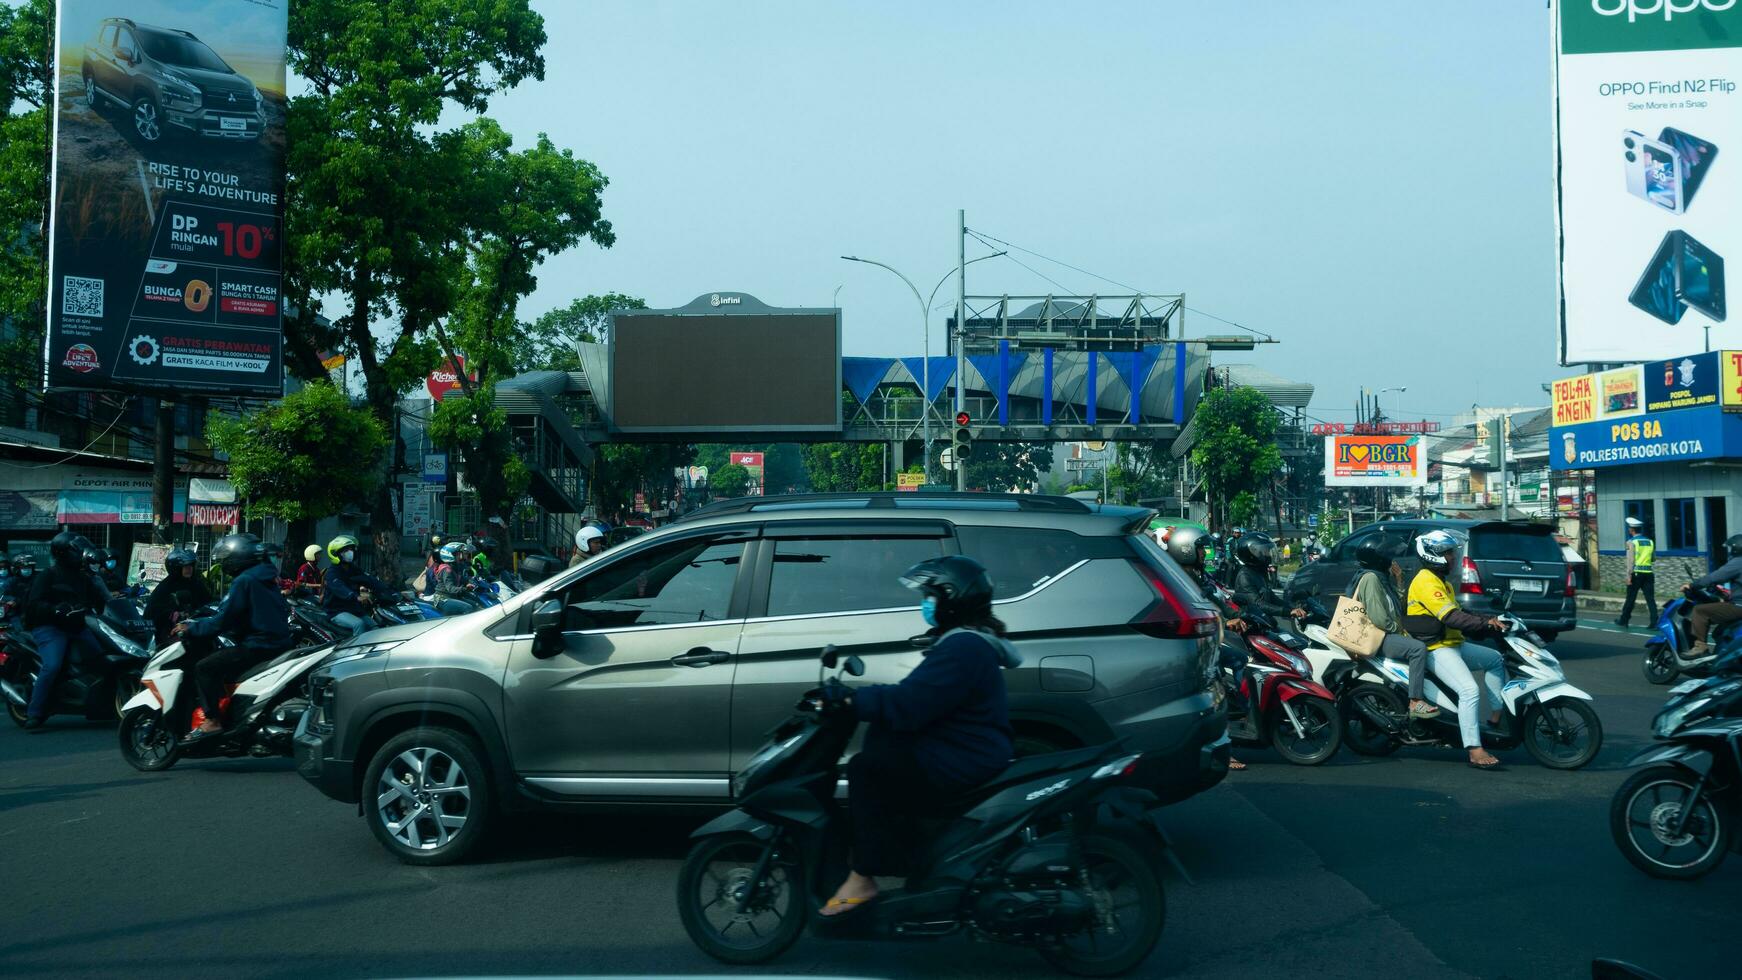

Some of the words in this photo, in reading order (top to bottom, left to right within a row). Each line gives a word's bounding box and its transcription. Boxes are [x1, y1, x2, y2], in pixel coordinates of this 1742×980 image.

[1599, 82, 1645, 96] OPPO
[1649, 81, 1681, 94] Find
[1684, 80, 1706, 93] N2
[1709, 79, 1736, 94] Flip
[1627, 102, 1644, 111] See
[1645, 101, 1668, 110] More
[1669, 100, 1678, 109] in
[1685, 99, 1707, 110] Snap
[149, 162, 179, 178] RISE
[183, 167, 200, 180] TO
[203, 171, 239, 186] YOUR
[155, 178, 195, 193] LIFE'S
[199, 184, 278, 205] ADVENTURE
[172, 214, 198, 231] DP
[170, 242, 194, 253] mulai
[171, 231, 218, 247] RINGAN
[144, 285, 182, 298] BUNGA
[221, 282, 252, 293] SMART
[254, 285, 277, 295] CASH
[221, 290, 242, 298] BUNGA
[163, 337, 201, 347] GRATIS
[204, 340, 271, 354] PERAWATAN
[166, 357, 193, 365] GRATIS
[195, 358, 215, 366] KACA
[216, 360, 233, 368] FILM
[1555, 378, 1592, 402] TOLAK
[1557, 399, 1592, 423] ANGIN
[1611, 422, 1640, 442] POS
[1643, 420, 1663, 439] 8A
[1340, 444, 1349, 463] I
[1369, 444, 1411, 463] BGR
[1580, 447, 1629, 463] POLRESTA
[1631, 443, 1669, 458] BOGOR
[1671, 439, 1703, 456] KOTA
[74, 479, 109, 487] DEPOT
[189, 505, 239, 526] PHOTOCOPY
